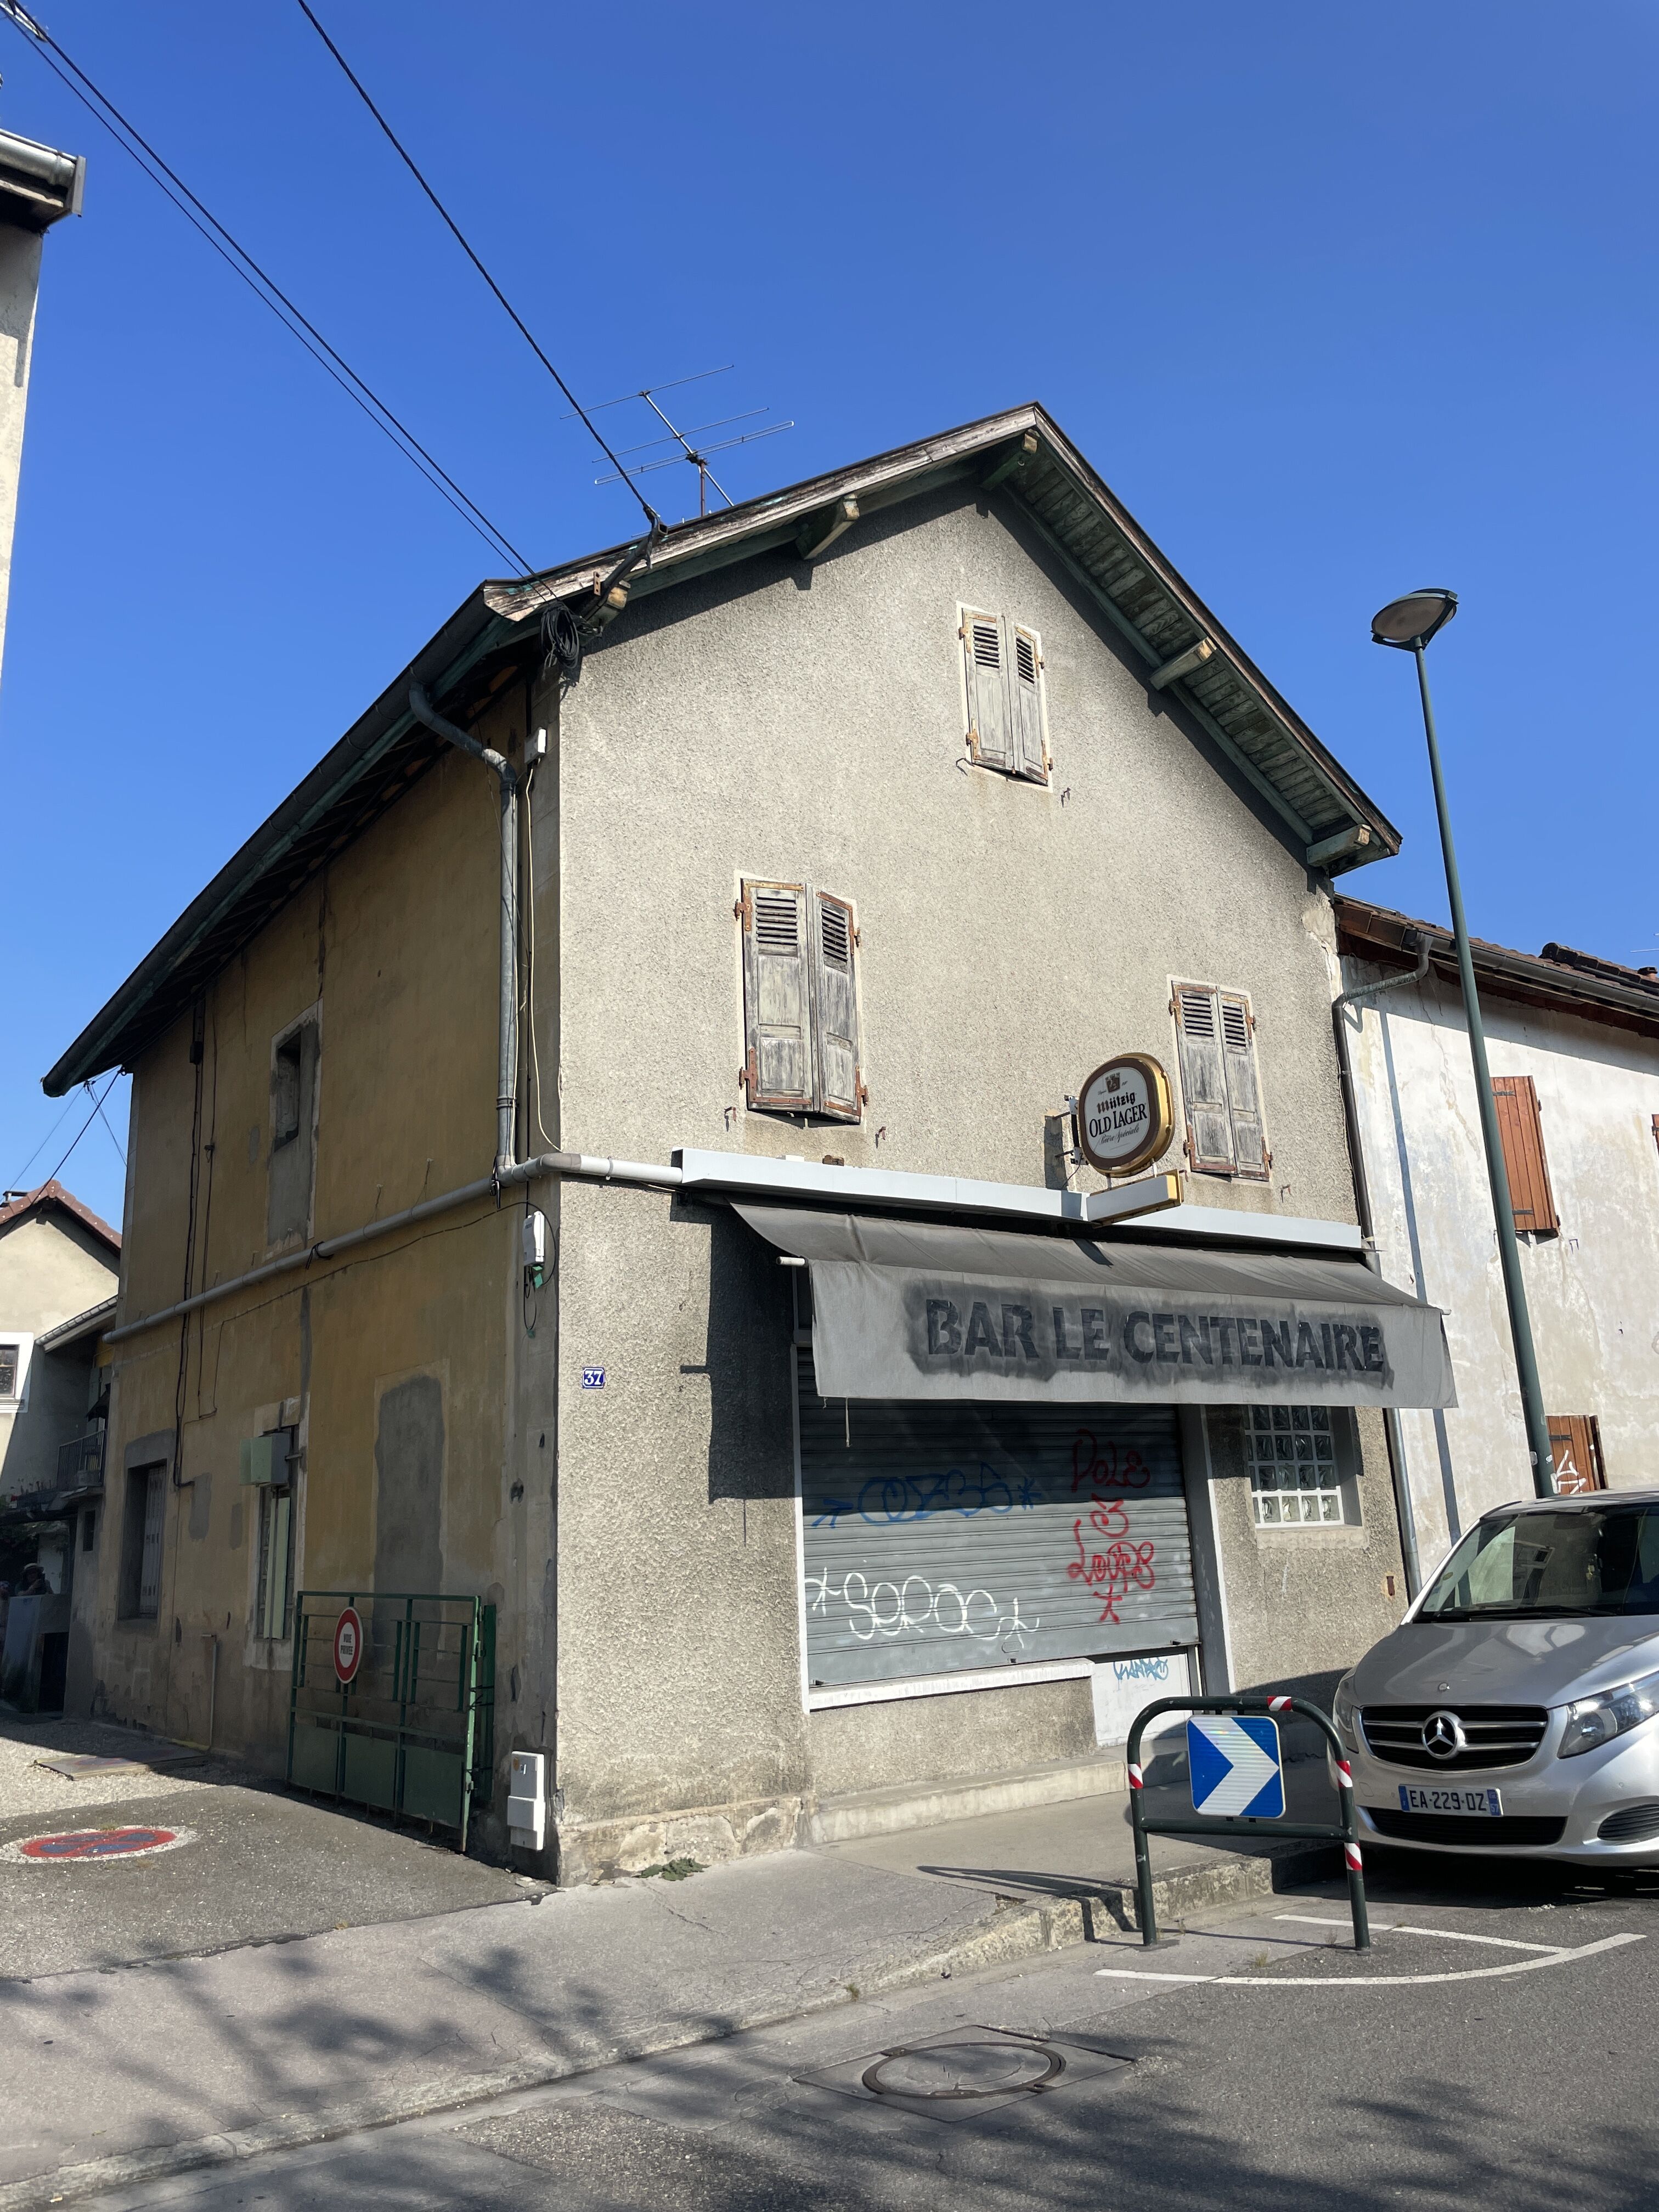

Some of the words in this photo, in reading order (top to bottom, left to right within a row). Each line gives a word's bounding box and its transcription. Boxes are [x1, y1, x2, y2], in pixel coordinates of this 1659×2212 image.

[1089, 1116, 1111, 1138] OLD
[1113, 1103, 1148, 1129] LAGER
[926, 1299, 1040, 1361] BAR
[1052, 1306, 1110, 1361] LE
[1123, 1311, 1384, 1372] CENTENAIRE
[584, 1370, 602, 1385] 37
[1409, 1790, 1487, 1811] EA-229-DZ
